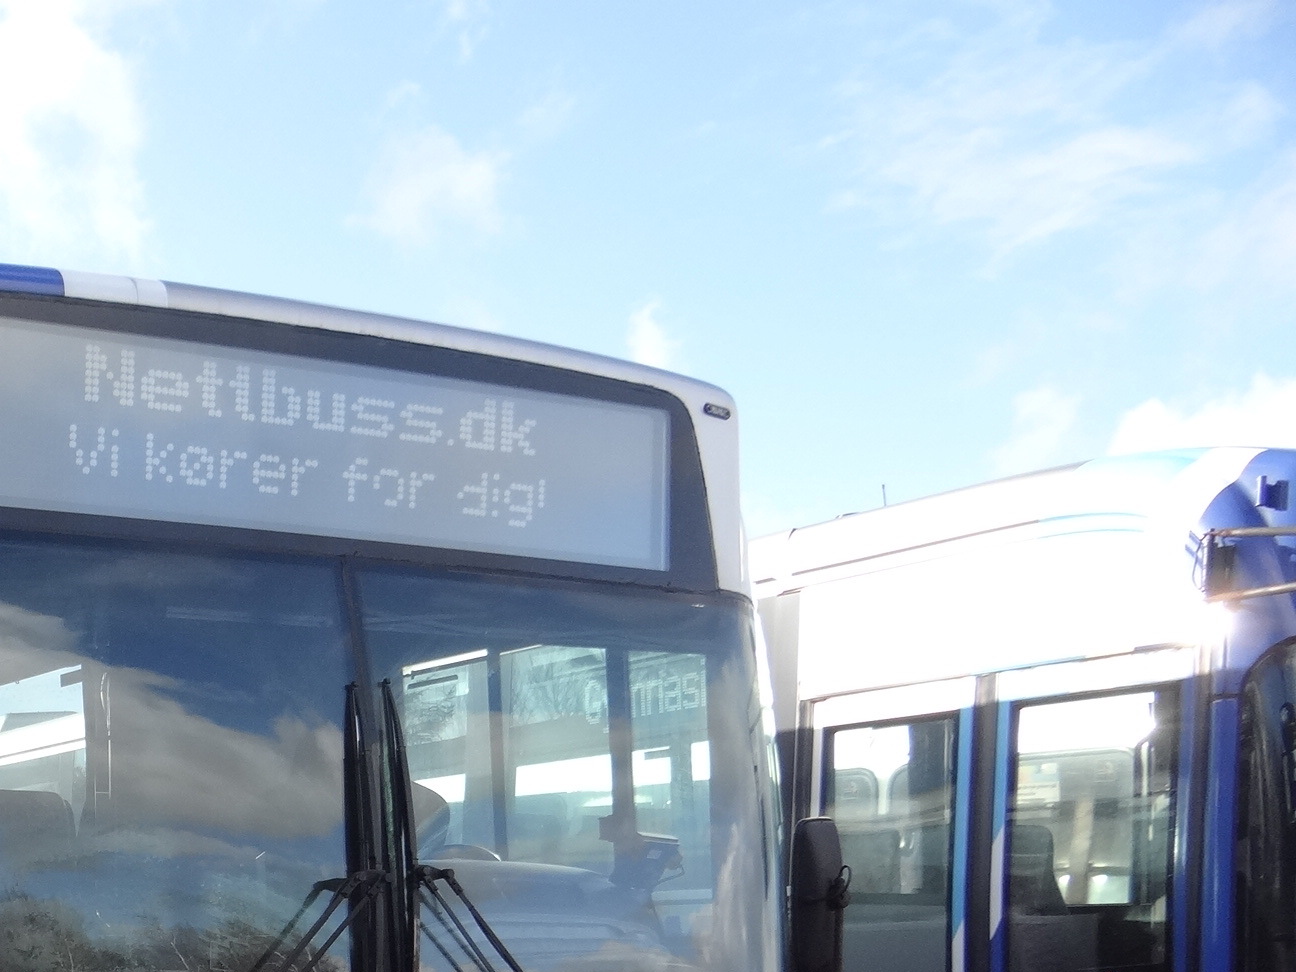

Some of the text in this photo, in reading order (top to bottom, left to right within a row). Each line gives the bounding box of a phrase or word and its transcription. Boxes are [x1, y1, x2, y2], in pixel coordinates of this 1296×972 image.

[84, 344, 537, 456] Nettbuss.dk
[68, 423, 119, 478] Vi
[145, 432, 319, 497] kører
[342, 456, 436, 510] for
